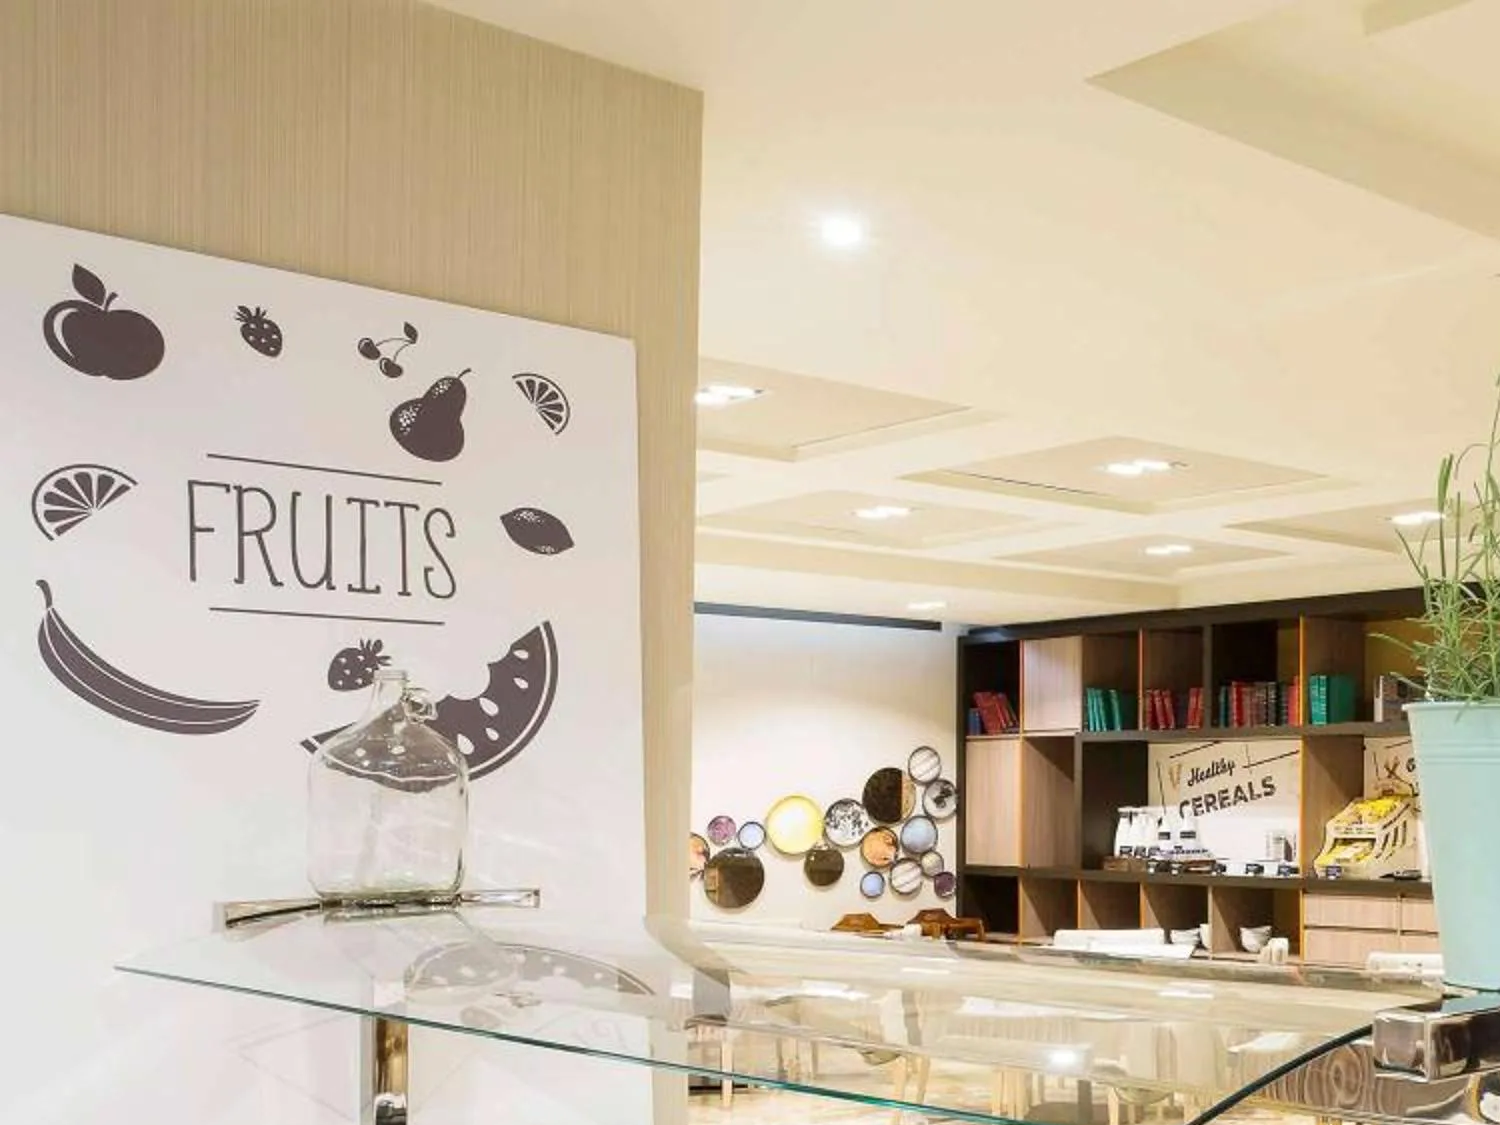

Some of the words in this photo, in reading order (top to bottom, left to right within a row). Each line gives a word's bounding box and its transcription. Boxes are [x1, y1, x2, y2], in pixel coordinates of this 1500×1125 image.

[187, 479, 457, 600] FRUITS
[1187, 757, 1236, 787] Healthy
[1178, 775, 1277, 819] CEREALS
